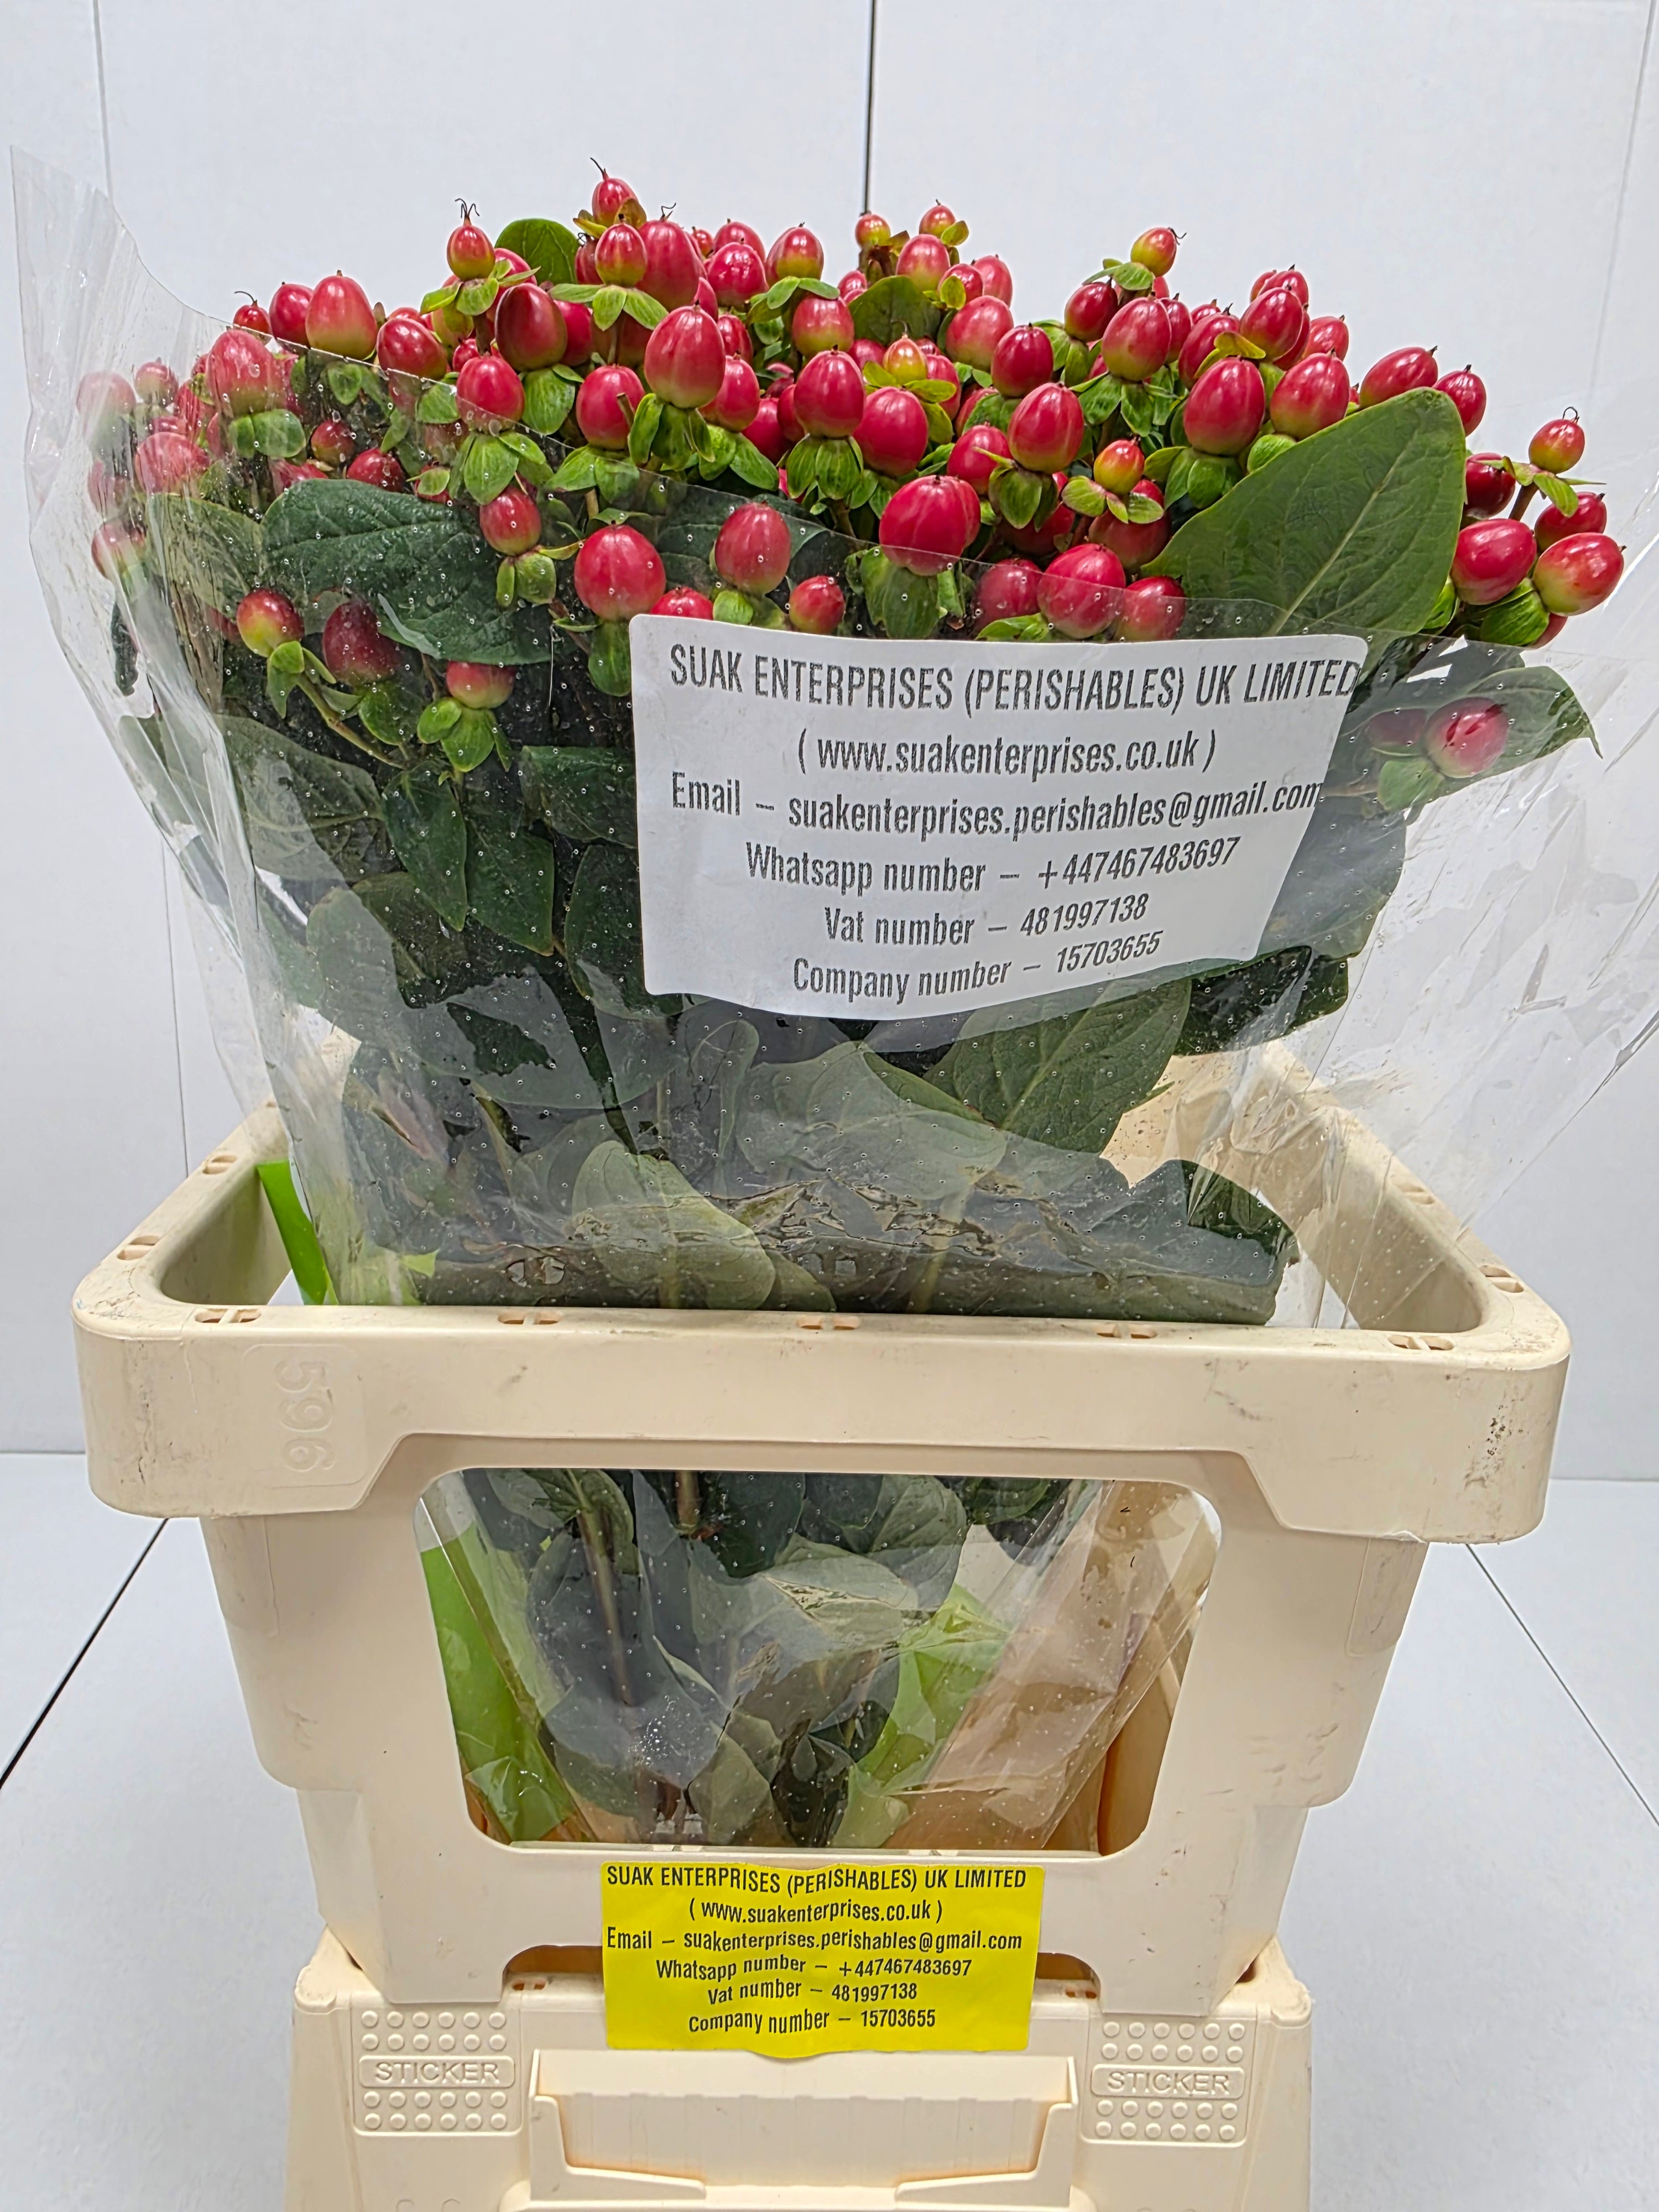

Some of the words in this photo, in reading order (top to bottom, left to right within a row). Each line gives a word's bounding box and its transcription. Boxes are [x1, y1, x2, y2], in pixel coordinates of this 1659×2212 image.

[671, 644, 743, 693] SUAK
[755, 655, 953, 710] ENTERPRISES
[965, 667, 1183, 718] (PERISHABLES)
[1196, 664, 1237, 706] UK
[1244, 659, 1362, 702] LIMITED
[672, 771, 740, 816] Email
[789, 780, 1323, 842] suakenterprises.perishables@gmail.com
[746, 842, 872, 896] Whatsapp
[884, 857, 986, 892] number
[1038, 837, 1241, 889] +447467483697
[825, 907, 863, 943] Vat
[875, 913, 974, 945] number
[1020, 893, 1149, 936] 481997138
[794, 958, 910, 1004] Company
[919, 961, 1011, 995] number
[1057, 930, 1163, 973] 15703655
[274, 1360, 335, 1472] 596
[607, 1866, 653, 1886] SUAK
[661, 1867, 780, 1893] ENTERPRISES
[787, 1869, 917, 1898] (PERISHABLES)
[925, 1870, 947, 1888] UK
[955, 1870, 1026, 1888] LIMITED
[607, 1927, 652, 1949] Email
[684, 1929, 1022, 1953] suakenterprises.perishables@gmail.com
[656, 1960, 737, 1982] Whatsapp
[744, 1954, 806, 1973] number
[839, 1959, 972, 1976] +447467483697
[708, 1986, 733, 2004] Vat
[740, 1979, 802, 1998] number
[832, 1983, 917, 2002] 481997138
[689, 2012, 762, 2034] Company
[769, 2009, 830, 2033] number
[860, 2009, 936, 2027] 15703655
[375, 2062, 500, 2083] STICKER
[1108, 2072, 1230, 2095] STICKER
